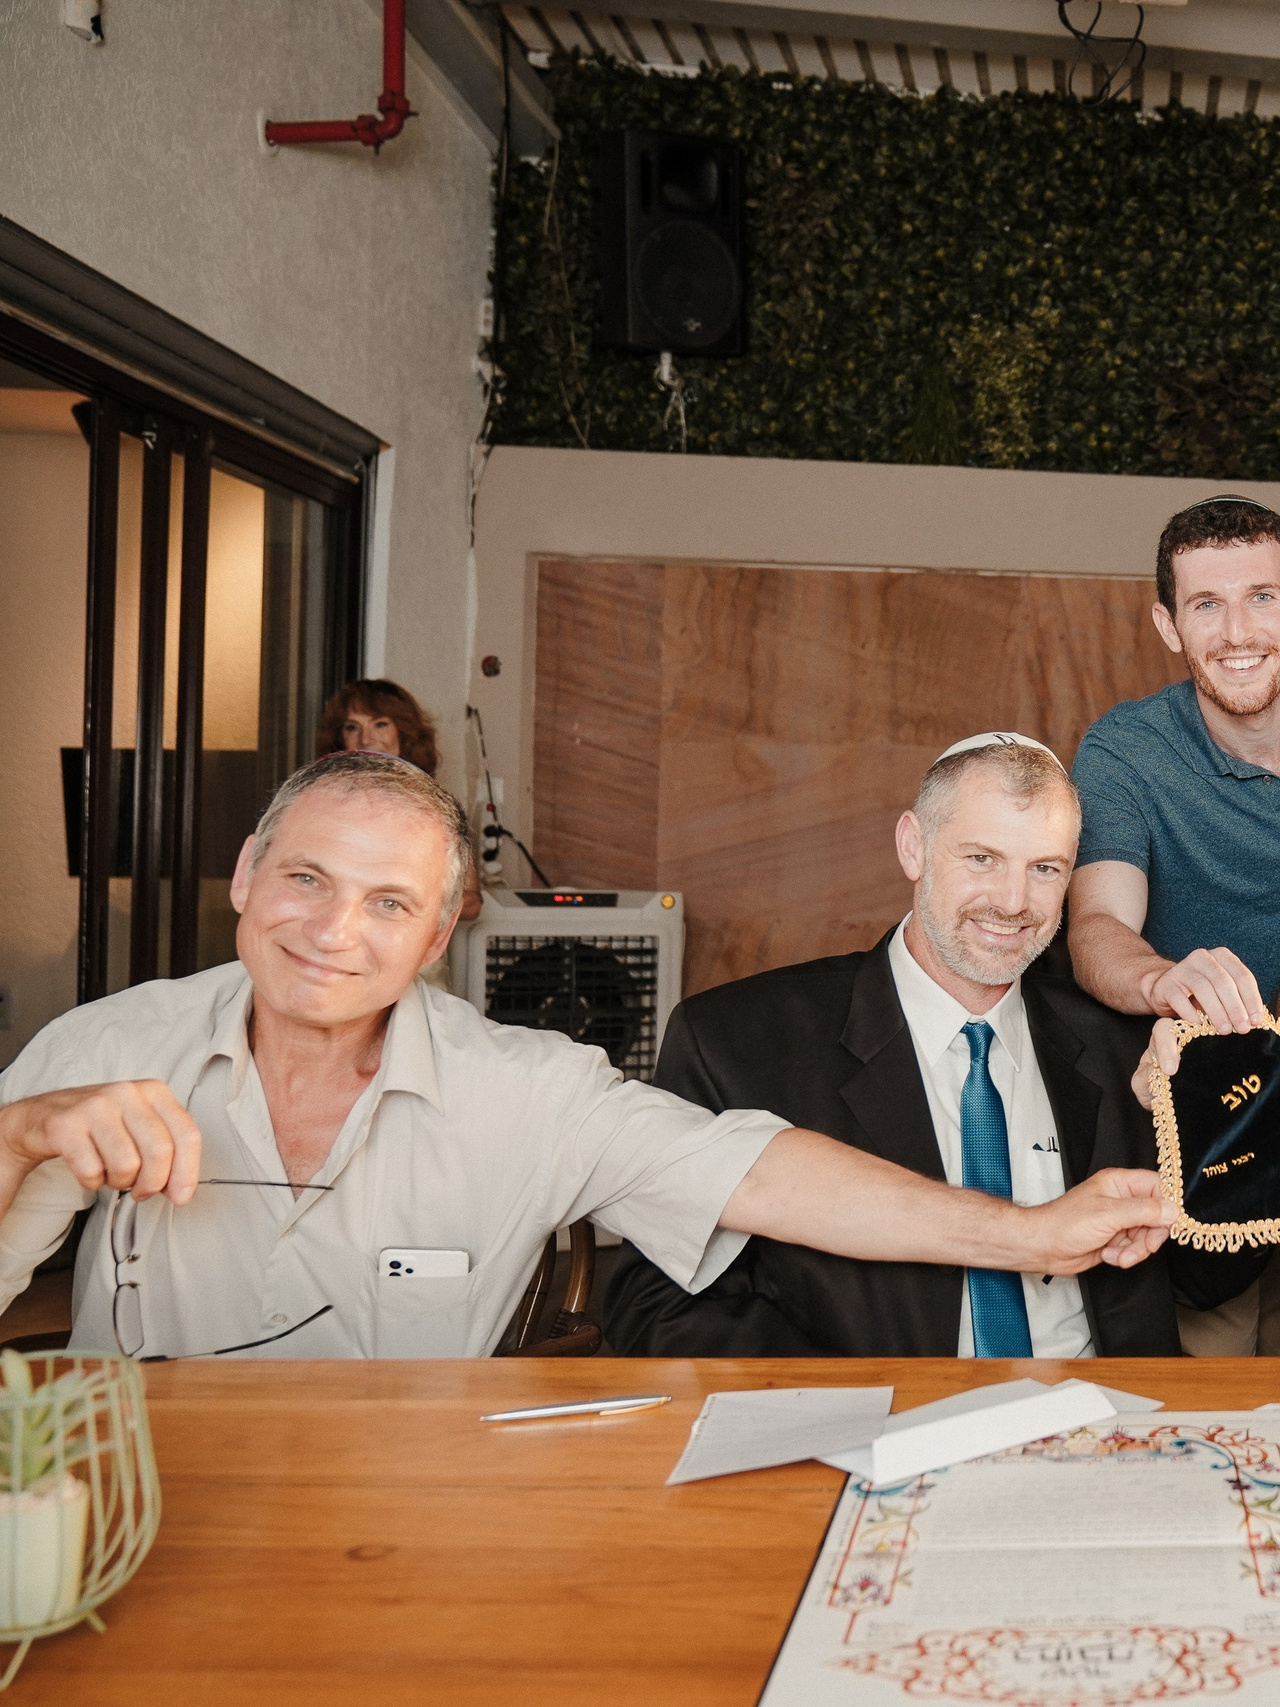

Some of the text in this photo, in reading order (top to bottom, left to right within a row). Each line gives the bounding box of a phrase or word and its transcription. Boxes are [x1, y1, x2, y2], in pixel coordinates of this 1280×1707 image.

[1221, 1074, 1261, 1111] טוב
[1202, 1152, 1255, 1178] רבני צוהר
